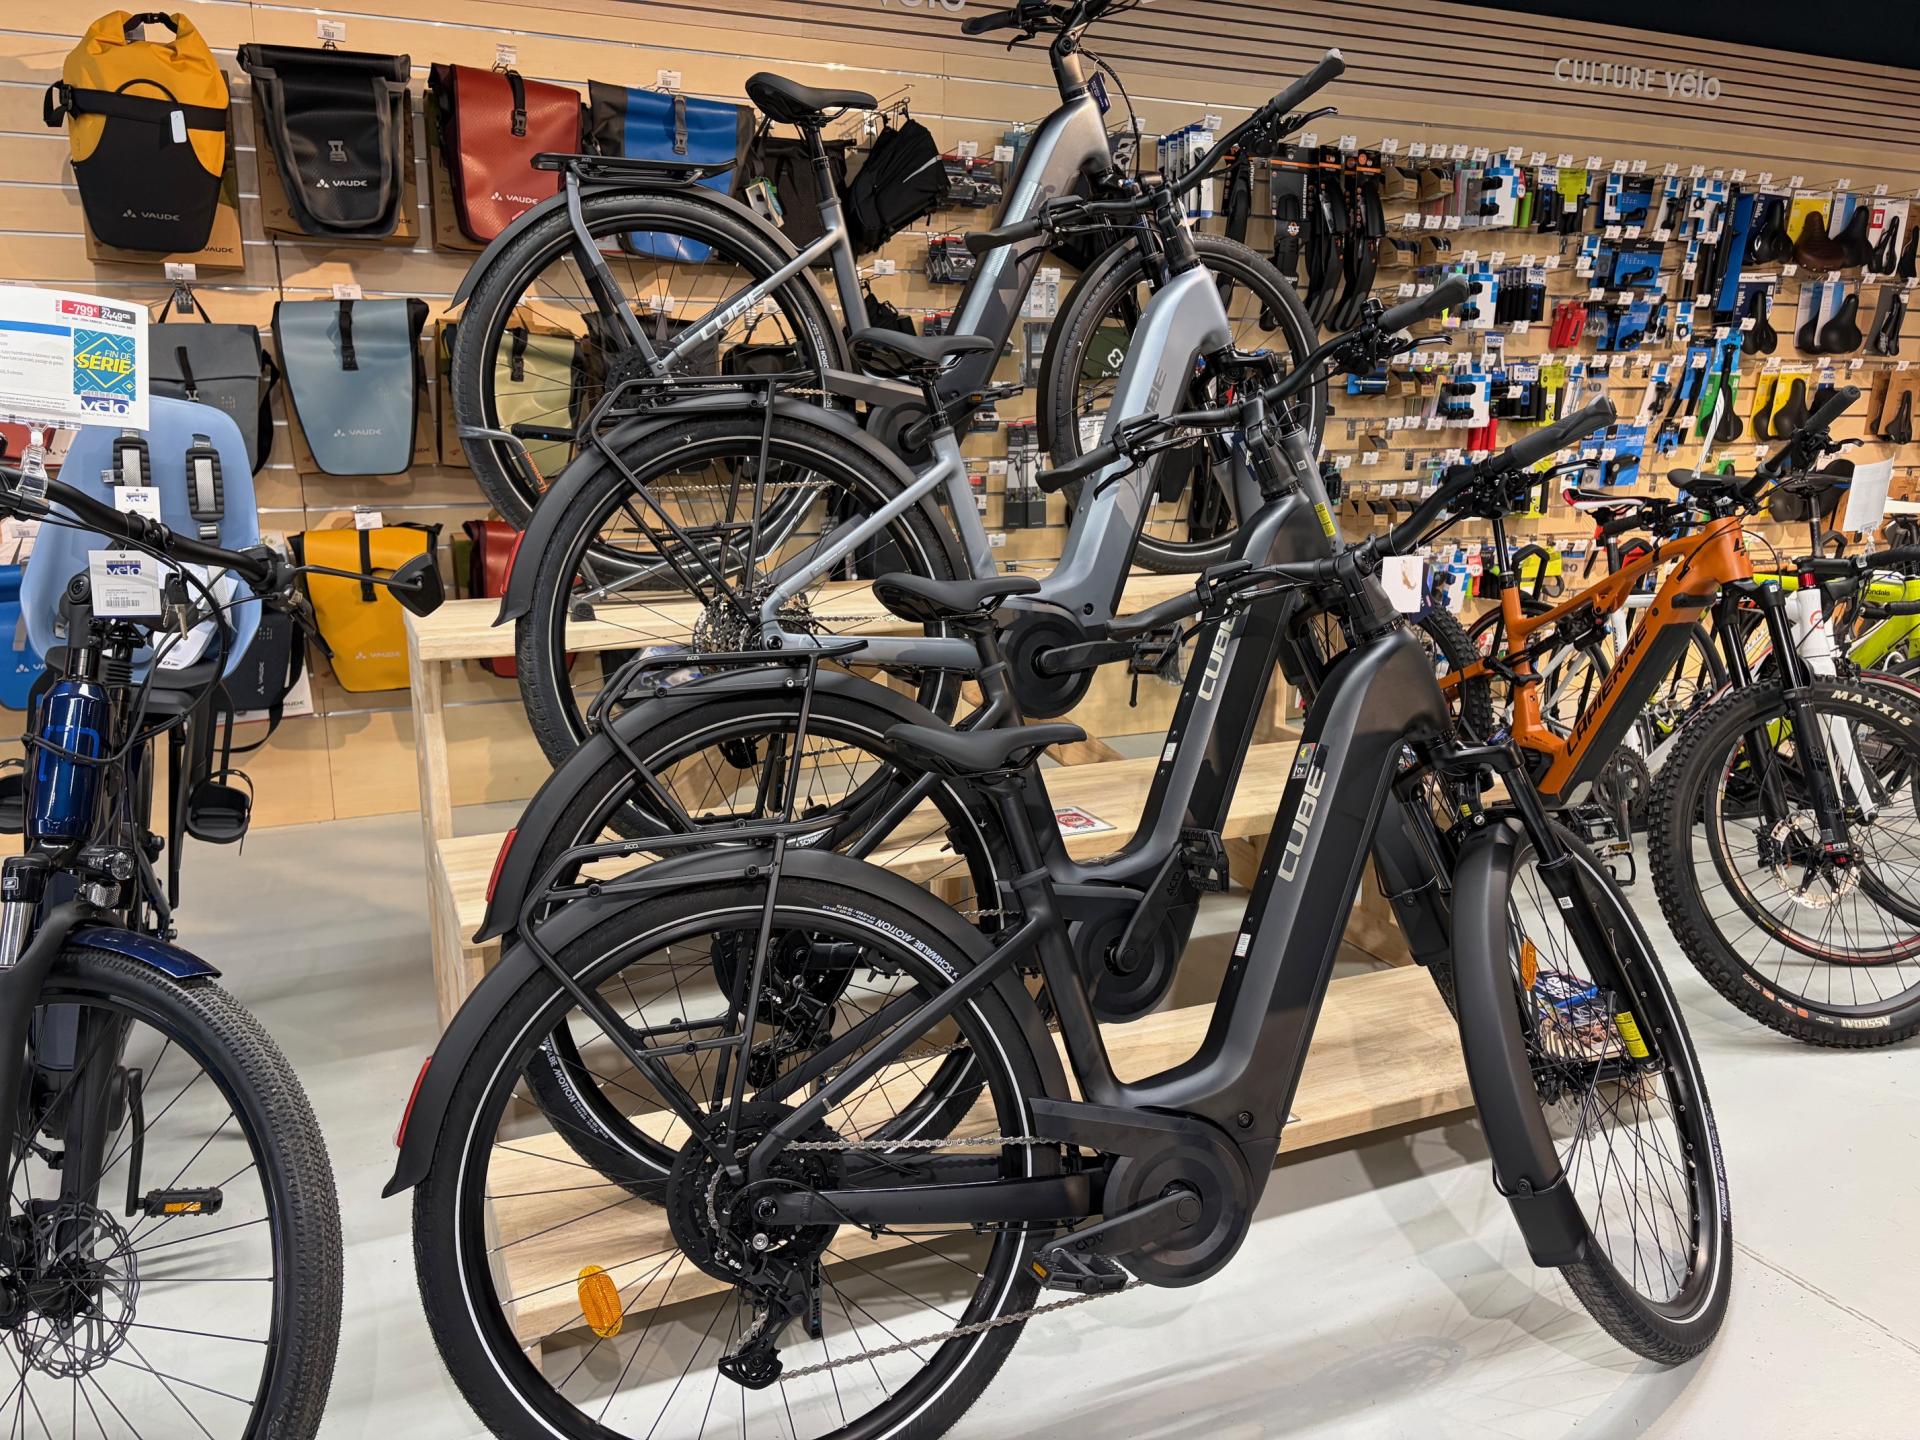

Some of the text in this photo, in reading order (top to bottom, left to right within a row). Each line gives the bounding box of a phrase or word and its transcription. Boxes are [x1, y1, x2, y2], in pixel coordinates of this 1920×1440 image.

[1554, 57, 1657, 92] CULTURE
[141, 211, 181, 220] VAUDE
[506, 194, 539, 205] VAUDE
[78, 351, 132, 375] SÉRIE
[104, 350, 132, 361] FIN DE
[348, 428, 383, 436] VAUDE
[1198, 616, 1237, 701] CUBE
[283, 699, 305, 707] AUDE
[1566, 624, 1648, 757] LAPIERRE
[1831, 689, 1914, 728] MAXXIS
[1277, 764, 1327, 882] CUBE
[874, 919, 955, 977] SCHWALBE MOTION
[552, 1067, 577, 1103] MOTION
